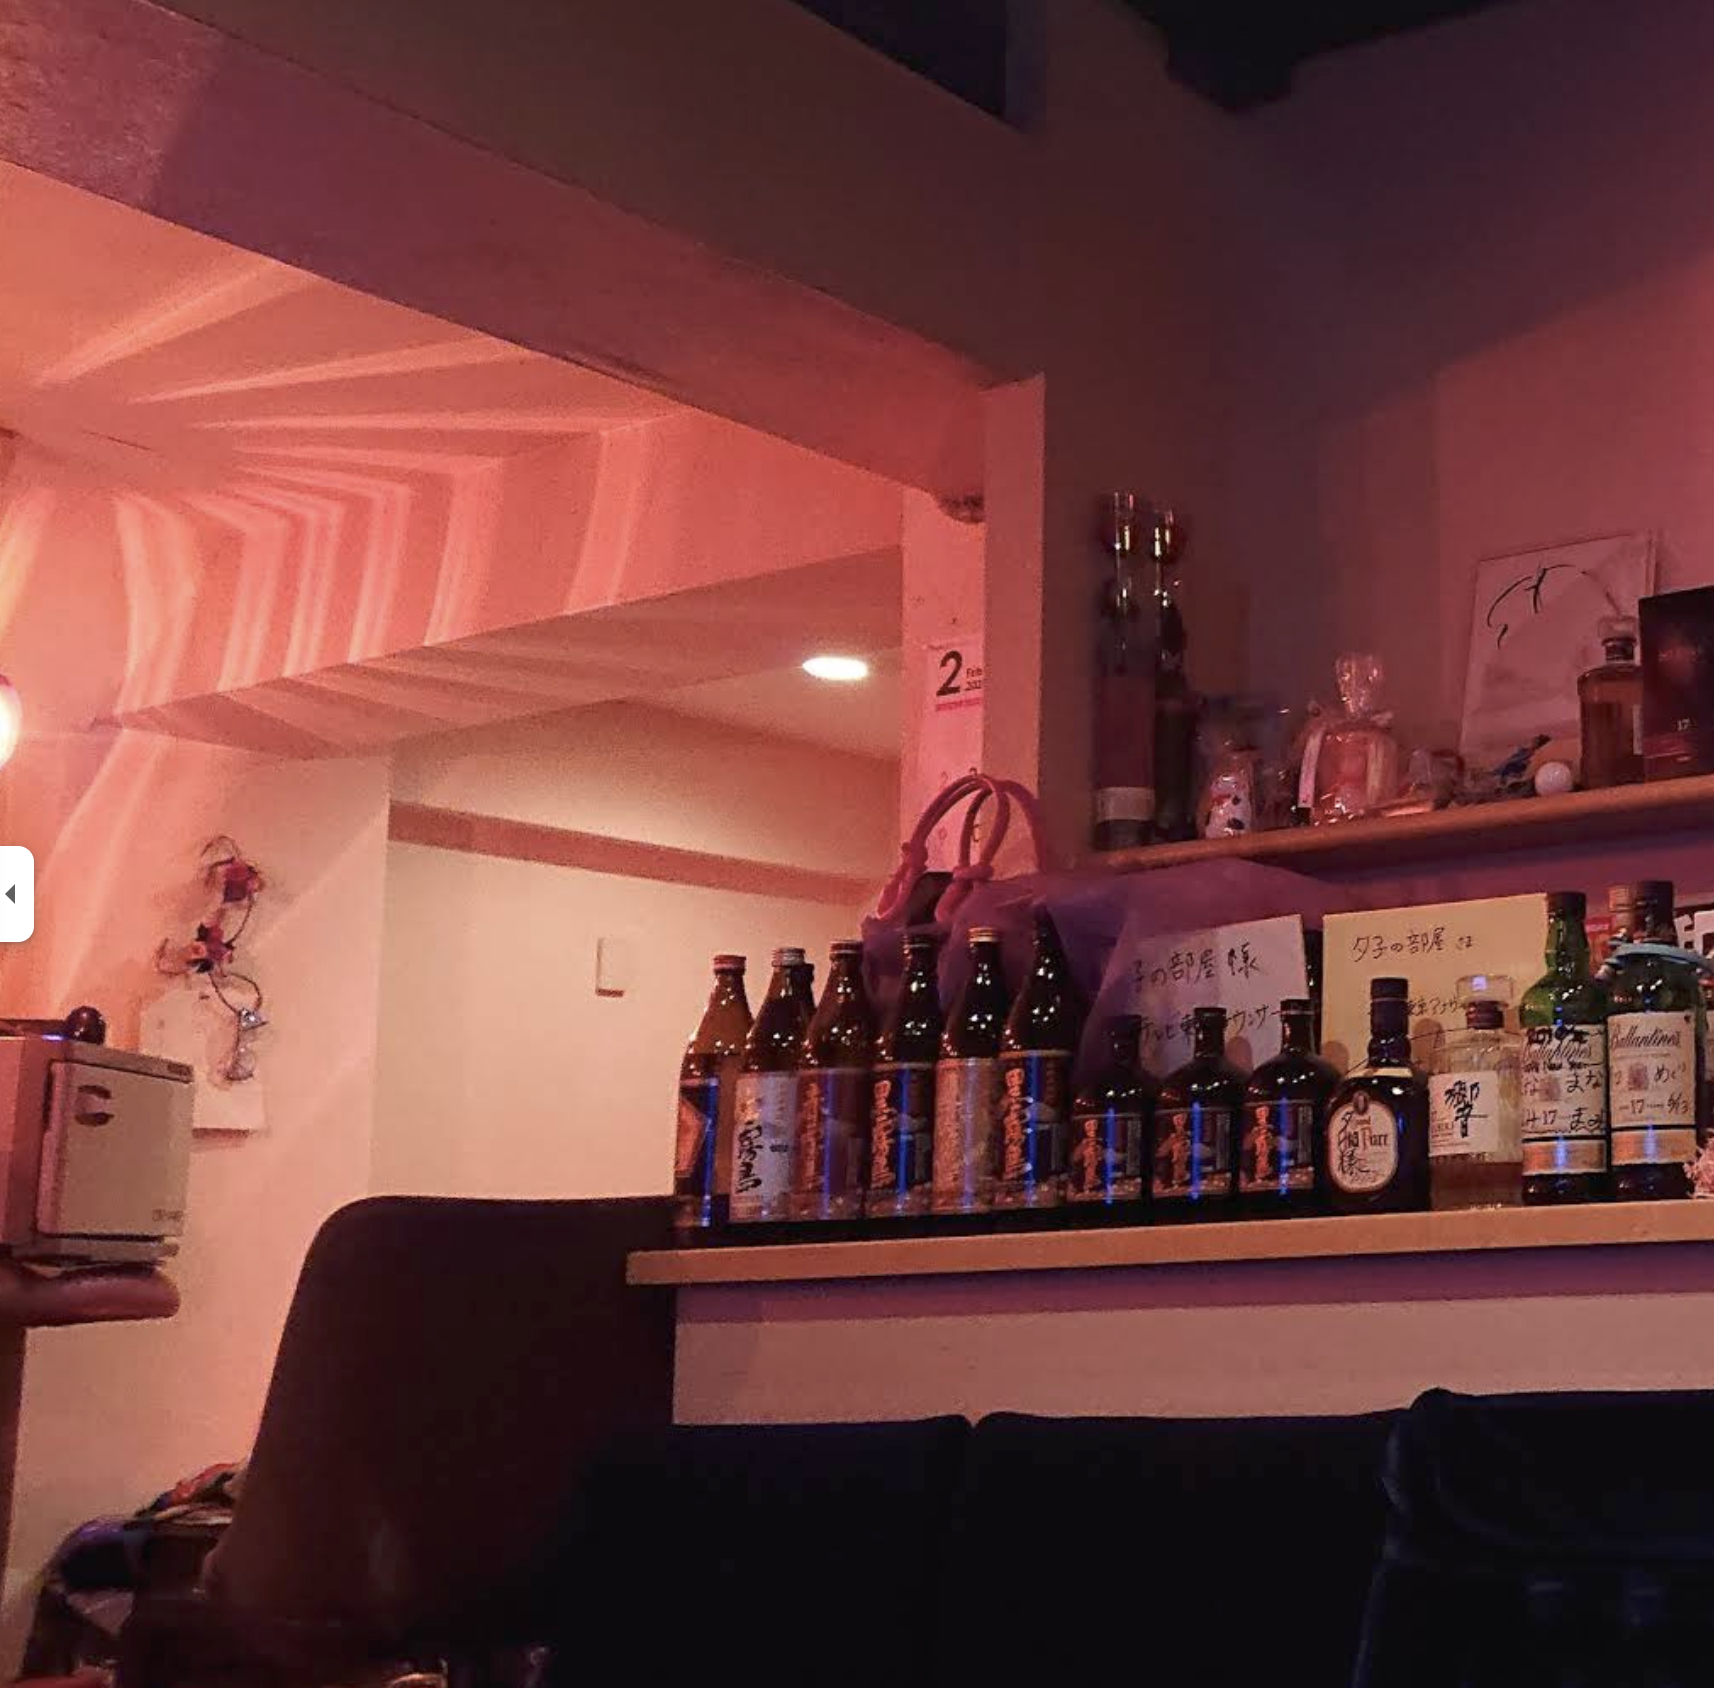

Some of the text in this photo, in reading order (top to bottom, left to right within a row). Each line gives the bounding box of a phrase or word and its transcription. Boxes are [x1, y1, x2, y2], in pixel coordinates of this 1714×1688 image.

[936, 650, 962, 697] 2
[1352, 926, 1446, 963] 夕子の部屋
[1444, 1080, 1489, 1139] 響
[1630, 1098, 1645, 1115] 17
